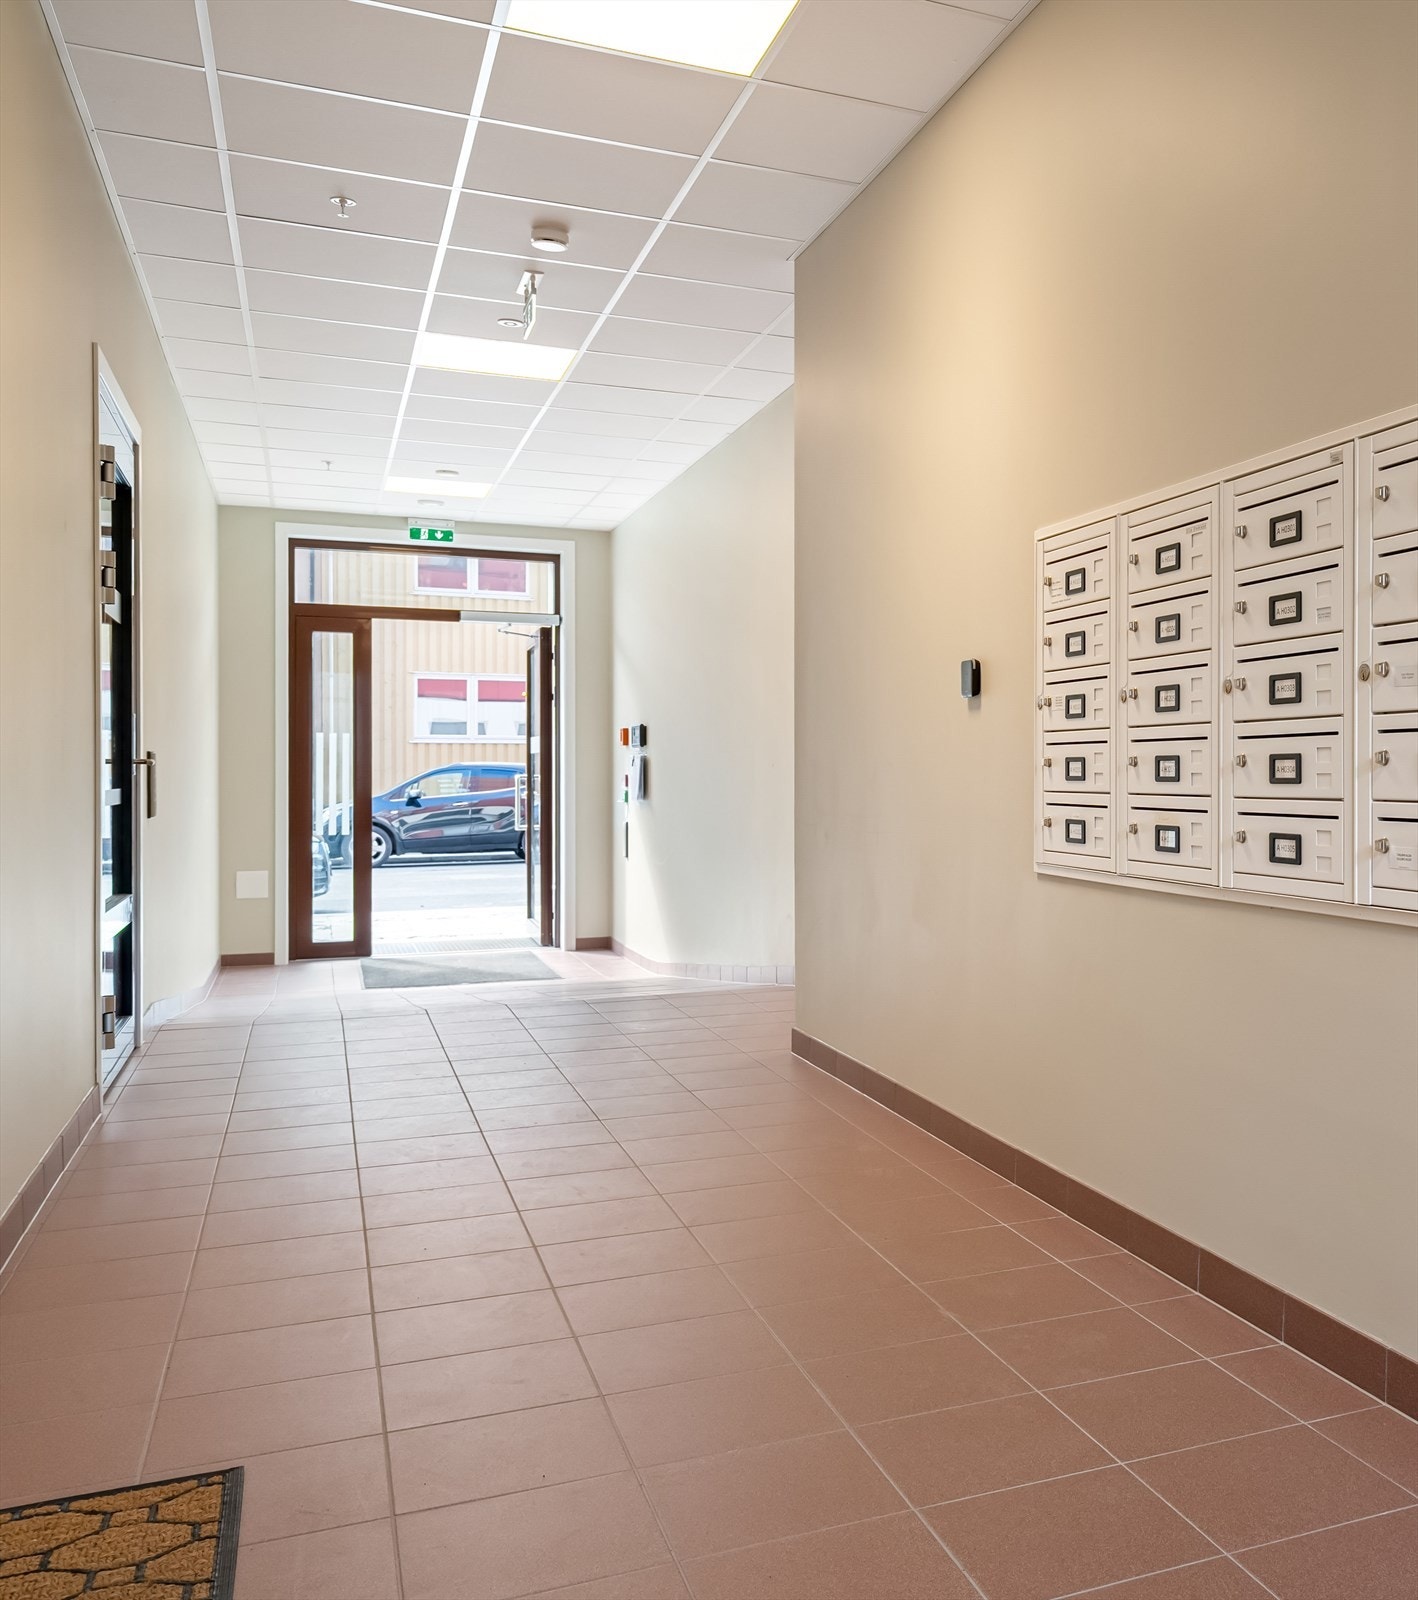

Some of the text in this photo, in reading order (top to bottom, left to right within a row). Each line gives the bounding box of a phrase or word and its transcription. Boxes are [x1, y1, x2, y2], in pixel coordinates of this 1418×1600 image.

[1280, 605, 1296, 615] H0302
[1280, 684, 1296, 693] H0303
[1280, 765, 1296, 774] H0304
[1280, 845, 1296, 853] H0305
